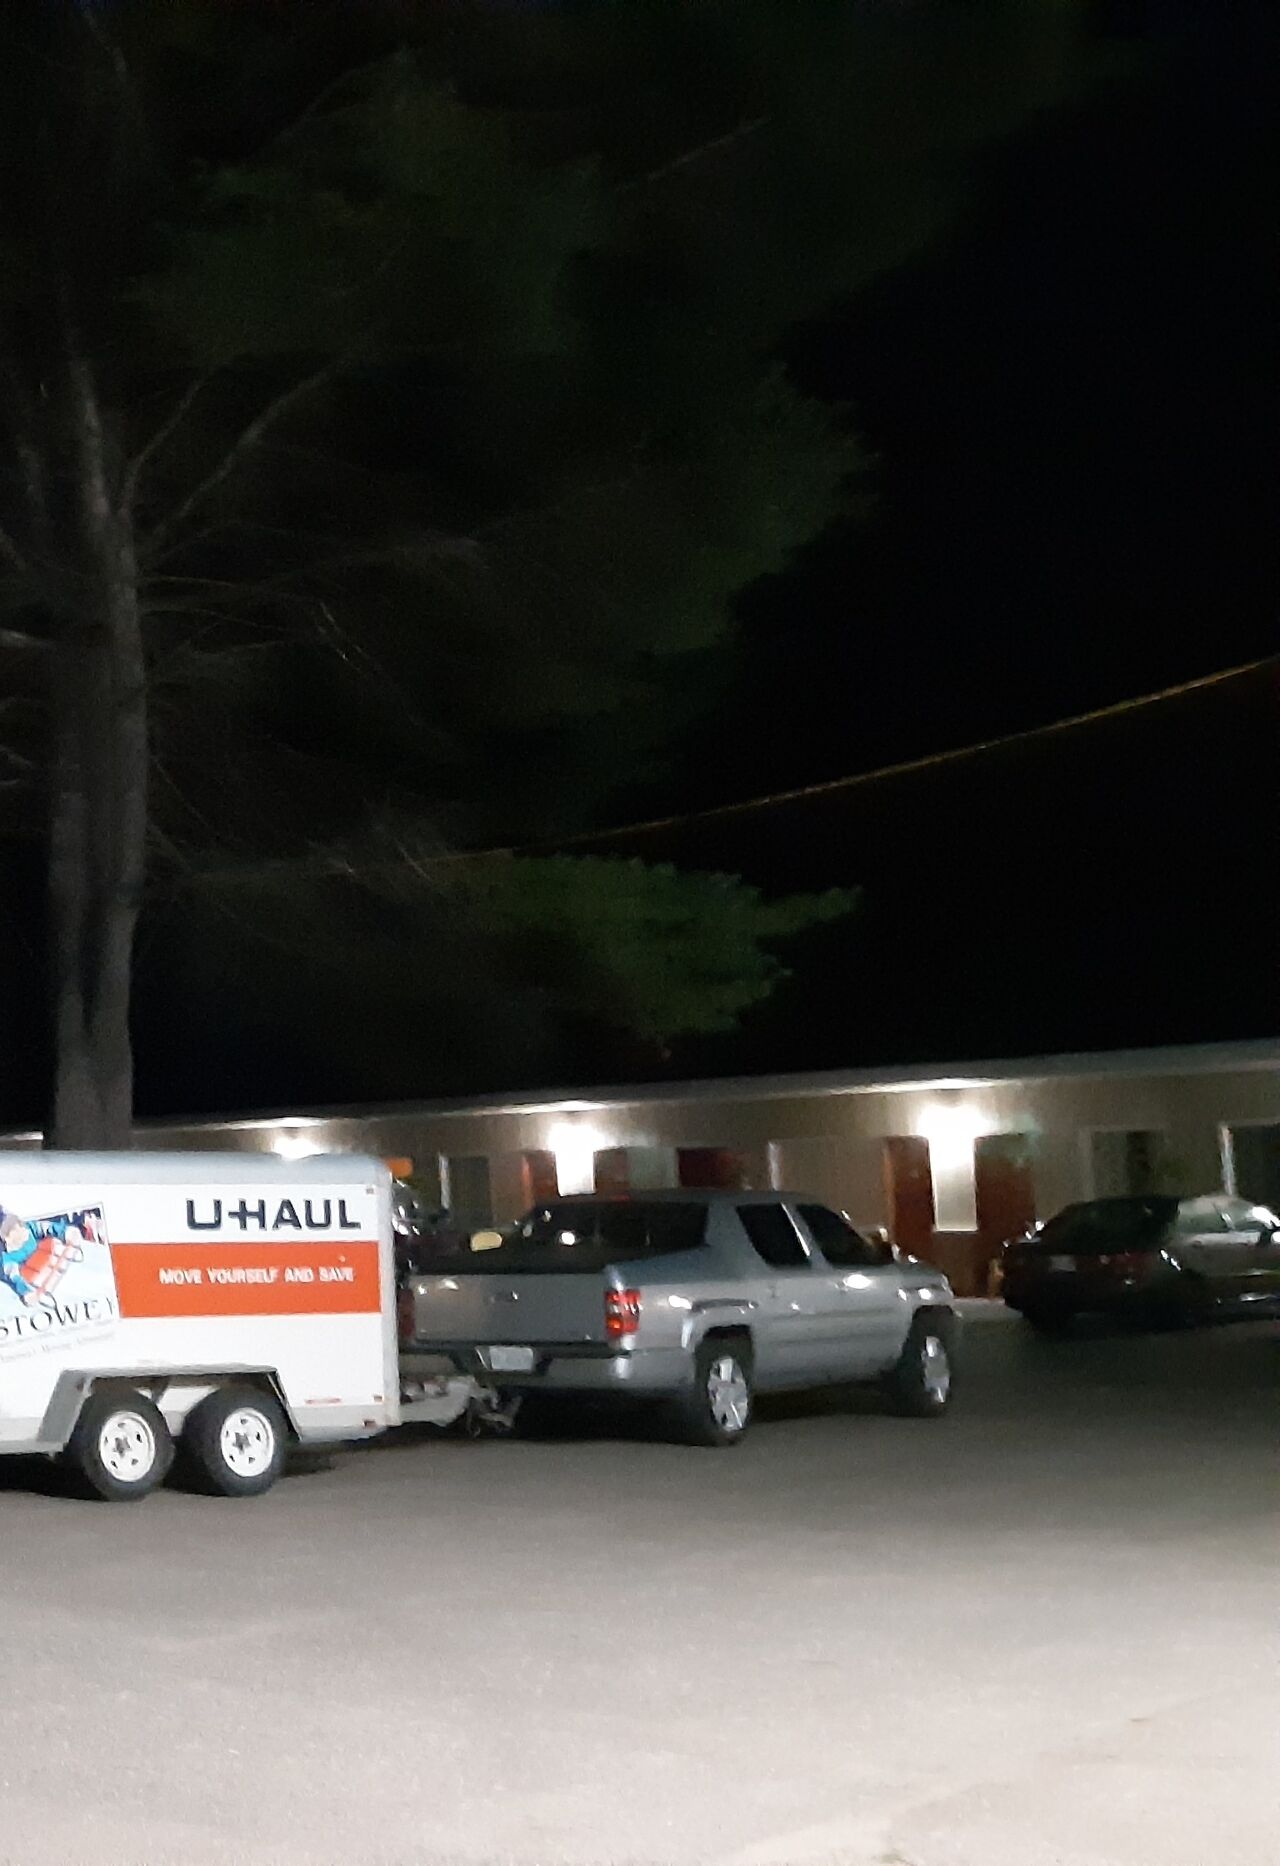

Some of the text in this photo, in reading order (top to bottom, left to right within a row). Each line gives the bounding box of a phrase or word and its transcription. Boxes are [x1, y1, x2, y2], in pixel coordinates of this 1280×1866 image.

[185, 1197, 362, 1231] U-HAUL
[158, 1266, 354, 1284] MOVE YOURSELF AND SAVE
